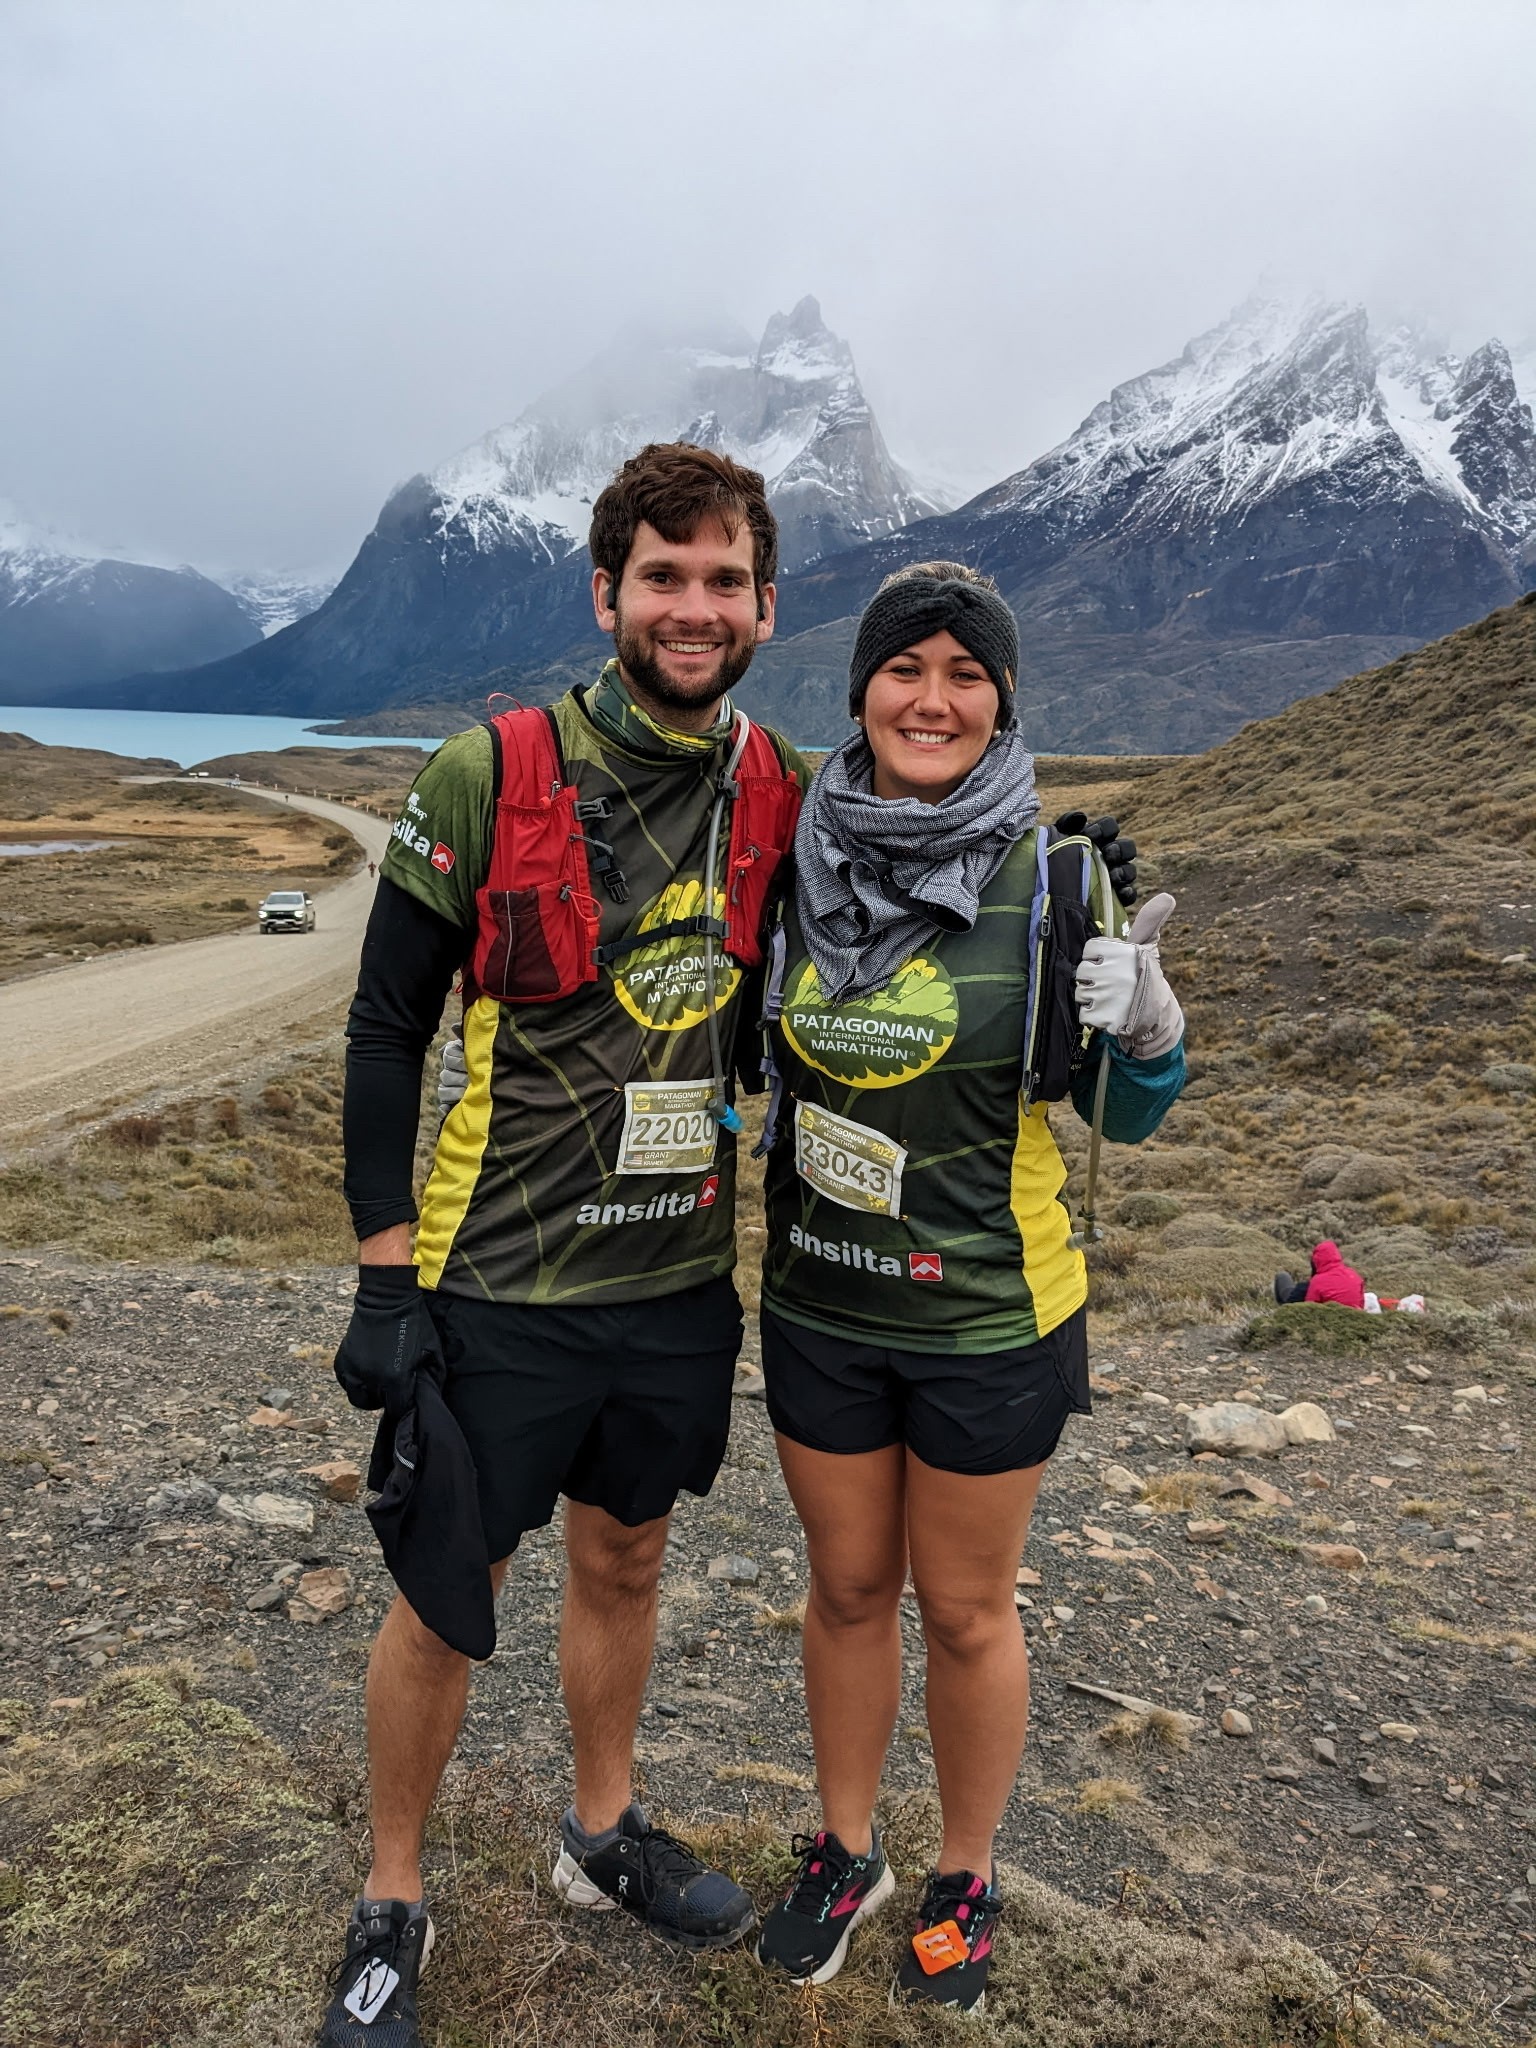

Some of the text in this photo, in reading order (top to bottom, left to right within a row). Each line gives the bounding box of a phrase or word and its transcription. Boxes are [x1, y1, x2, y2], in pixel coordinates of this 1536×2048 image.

[793, 1013, 935, 1044] PATAGONIAN
[819, 1031, 897, 1046] INTERNATIONAL
[632, 1113, 715, 1146] 22020
[819, 1118, 867, 1146] PATAGONIAN
[871, 1142, 897, 1160] 2022
[644, 1152, 670, 1160] GRANT
[801, 1133, 887, 1193] 23043
[811, 1167, 846, 1192] STEPHANIE
[576, 1192, 696, 1225] ansilta
[789, 1223, 902, 1277] ansilta
